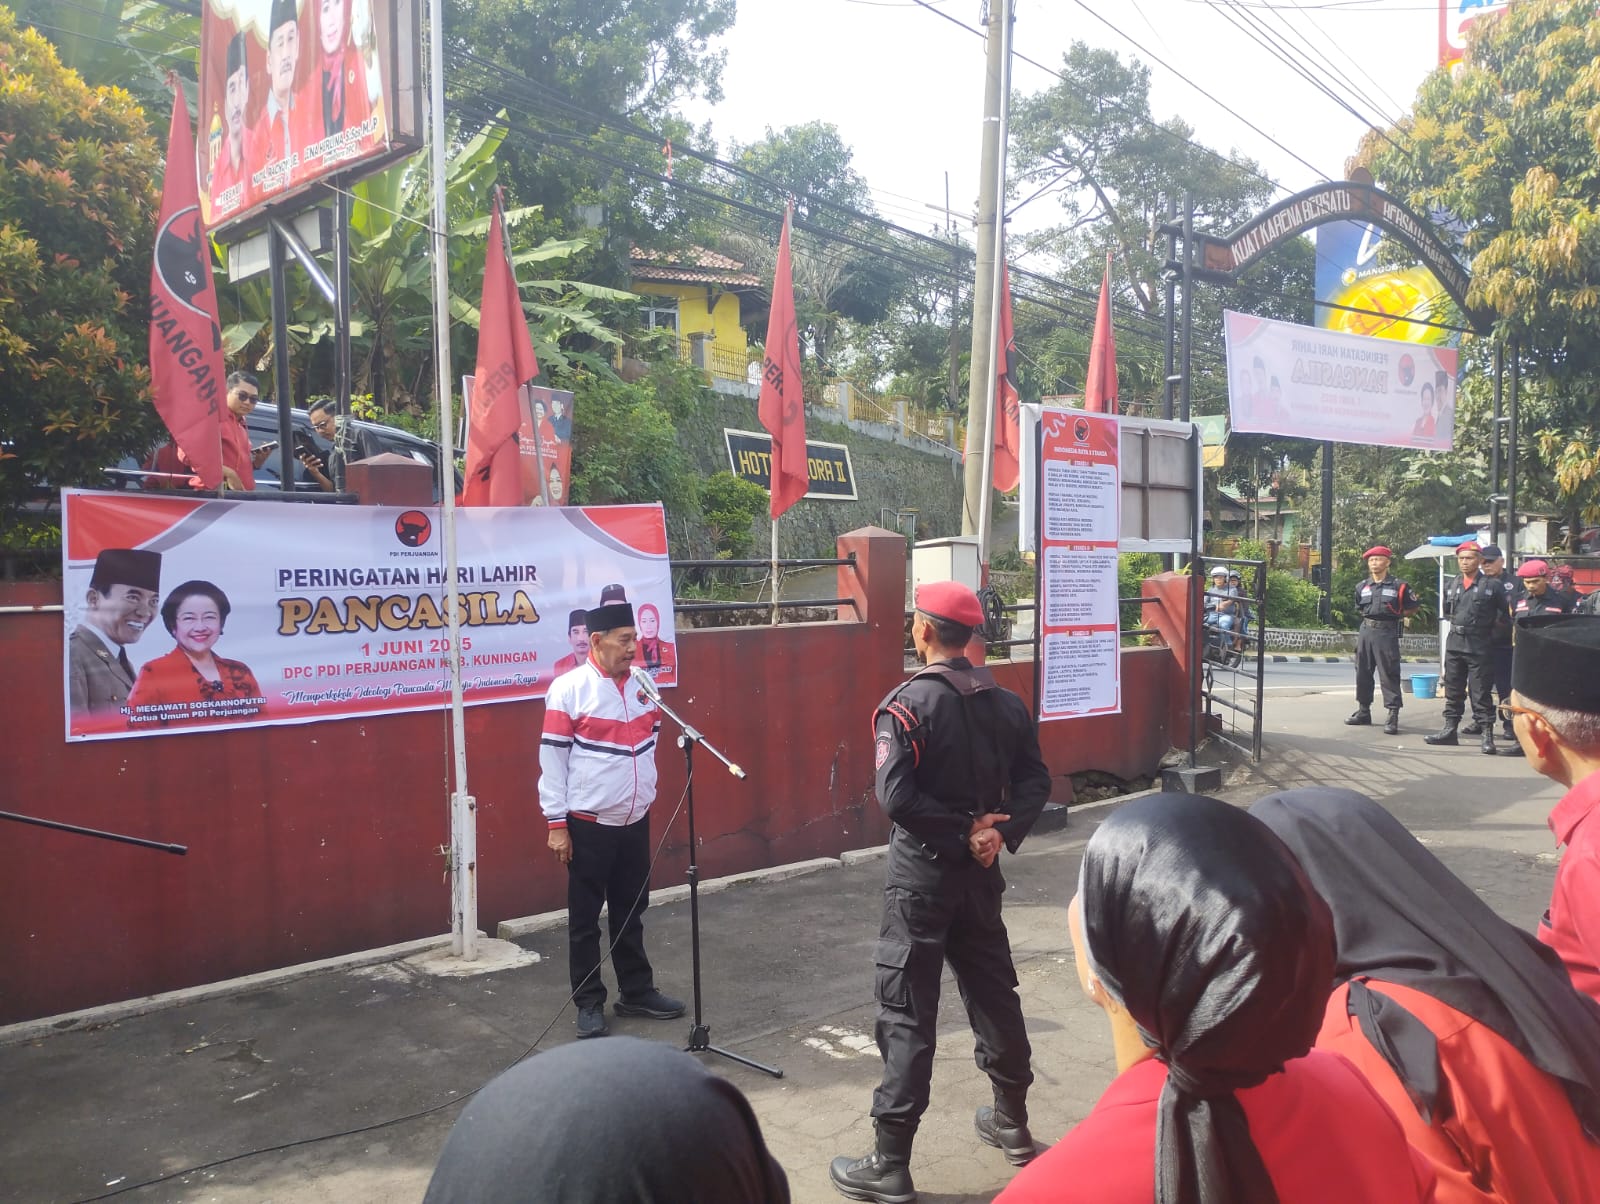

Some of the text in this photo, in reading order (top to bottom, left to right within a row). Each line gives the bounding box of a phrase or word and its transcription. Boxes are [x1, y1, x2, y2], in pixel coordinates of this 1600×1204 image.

[1231, 188, 1351, 266] KUAT KARENA BERSATU
[277, 566, 421, 588] PERINGATAN
[481, 565, 538, 584] LAHIR
[278, 590, 540, 636] PANCASILA
[361, 637, 472, 657] 1 JUNI 205
[283, 650, 538, 680] DPC PDI PERJUANGAN KB. KUNINGAN
[354, 684, 392, 700] Ideologi
[393, 682, 435, 695] Pancasila
[473, 675, 512, 690] Indonesia
[120, 696, 267, 715] Hj. MEGAWATI SOEKARNOPUTRI
[130, 714, 158, 723] Ketua
[160, 712, 190, 721] Umum
[209, 707, 259, 717] Perjuangan
